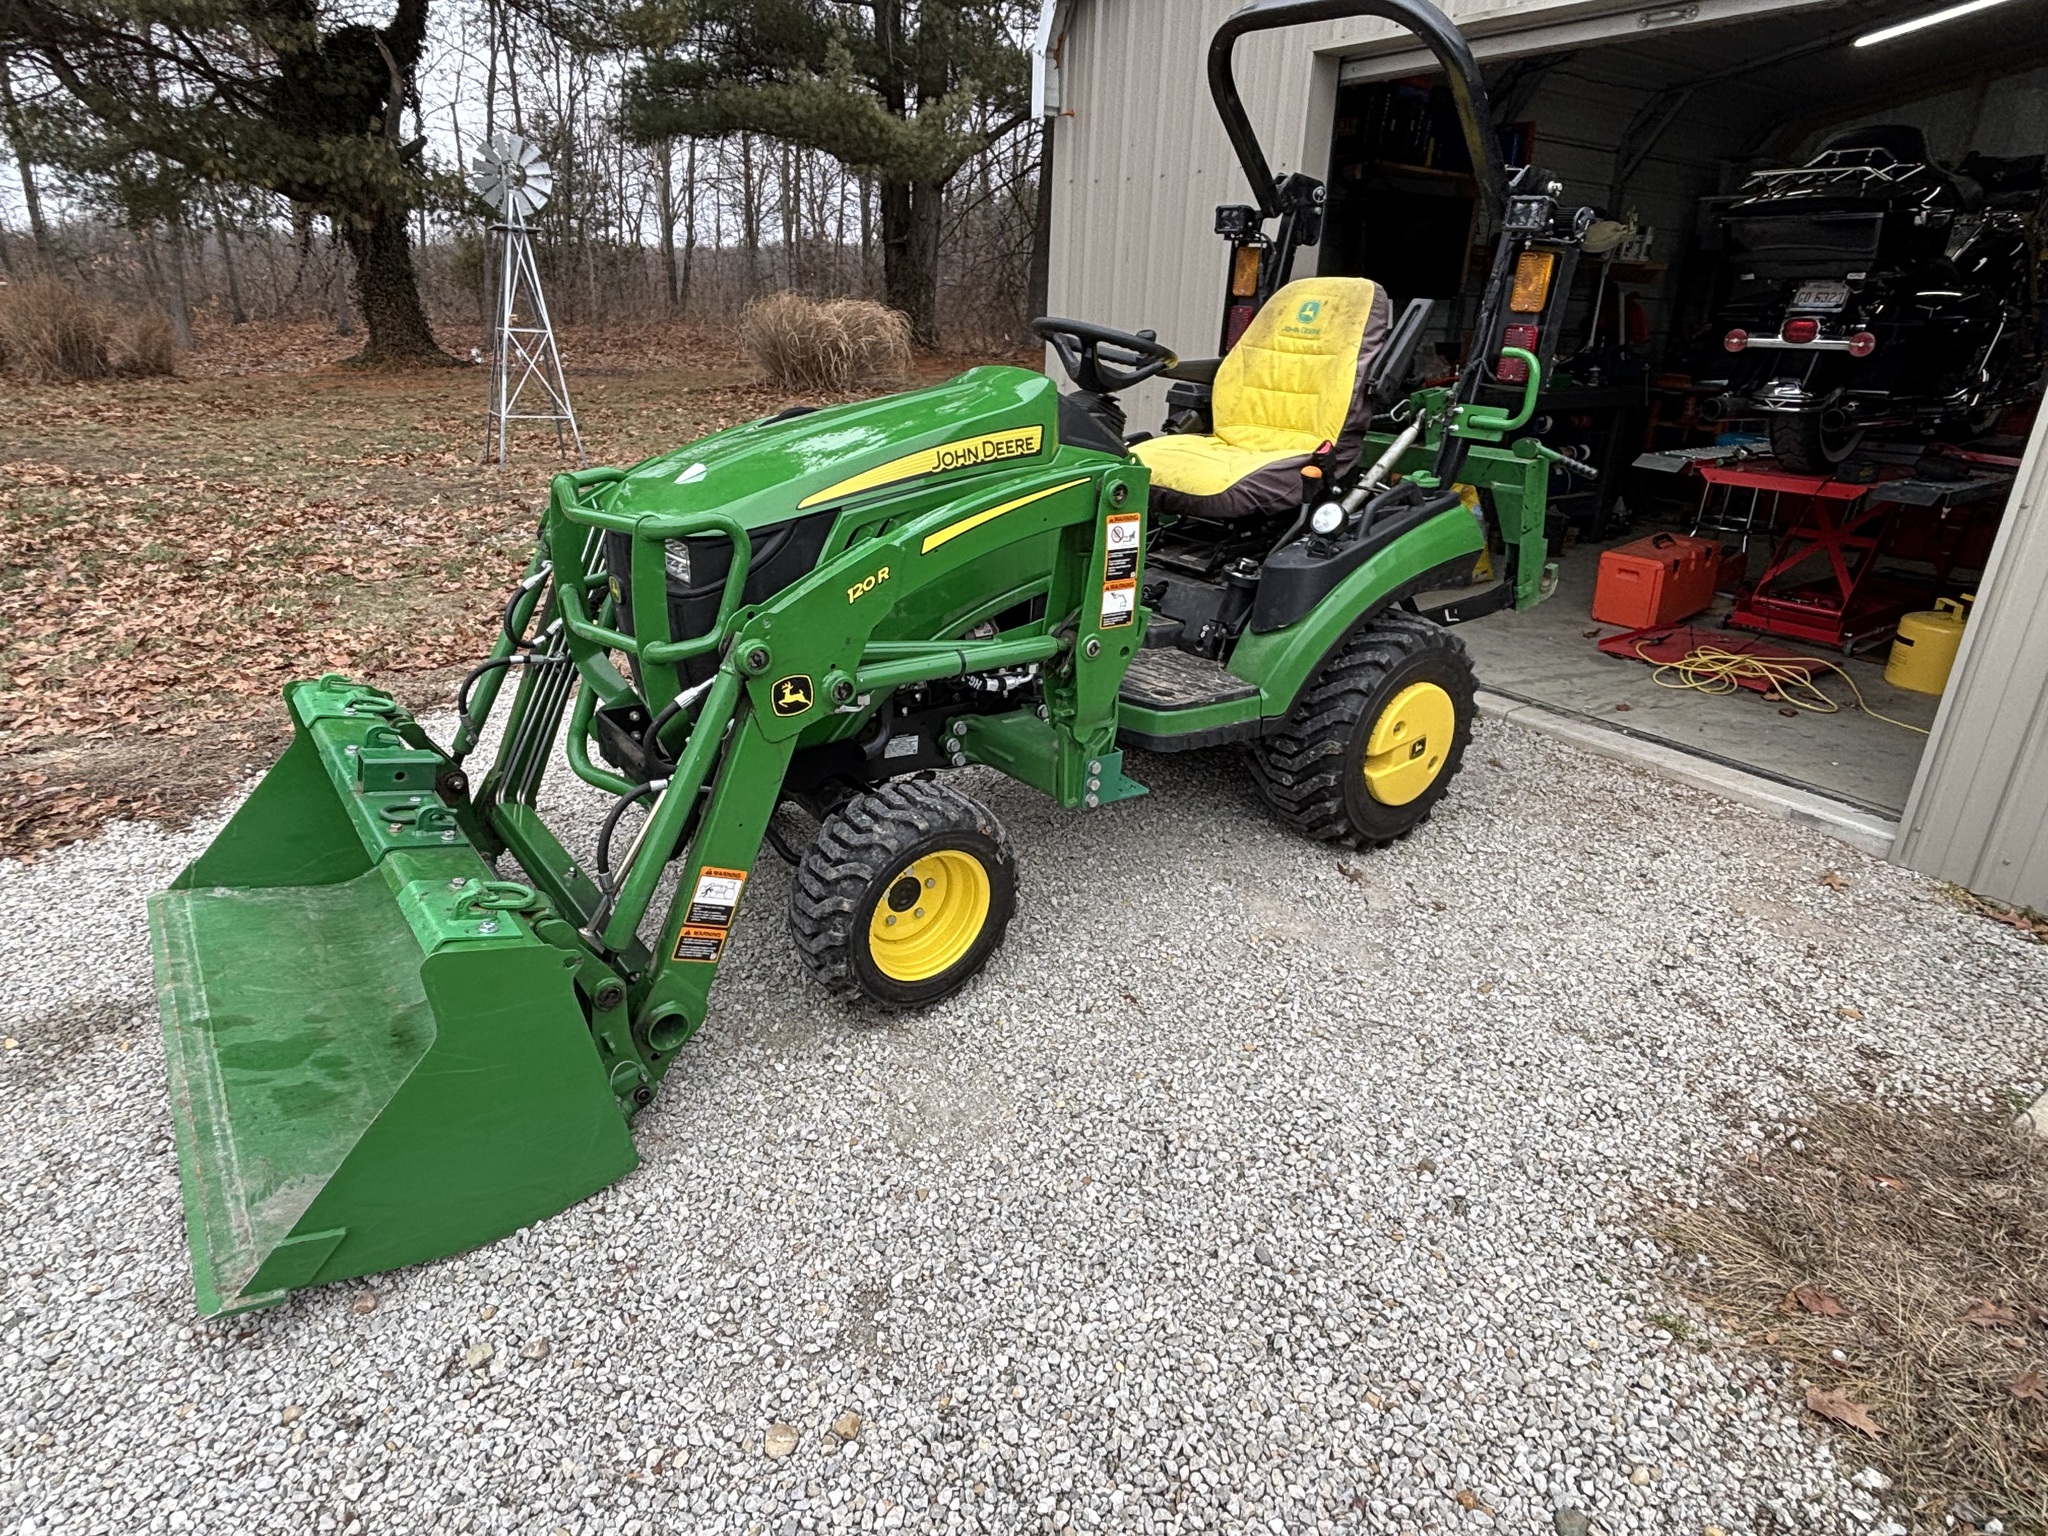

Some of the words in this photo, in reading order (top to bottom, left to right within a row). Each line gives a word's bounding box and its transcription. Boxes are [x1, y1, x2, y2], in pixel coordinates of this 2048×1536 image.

[932, 446, 979, 470] JOHN
[982, 437, 1035, 458] DEERE
[847, 575, 876, 604] 120
[877, 566, 890, 584] R
[713, 870, 741, 879] WARNING
[693, 930, 722, 938] WARNING
